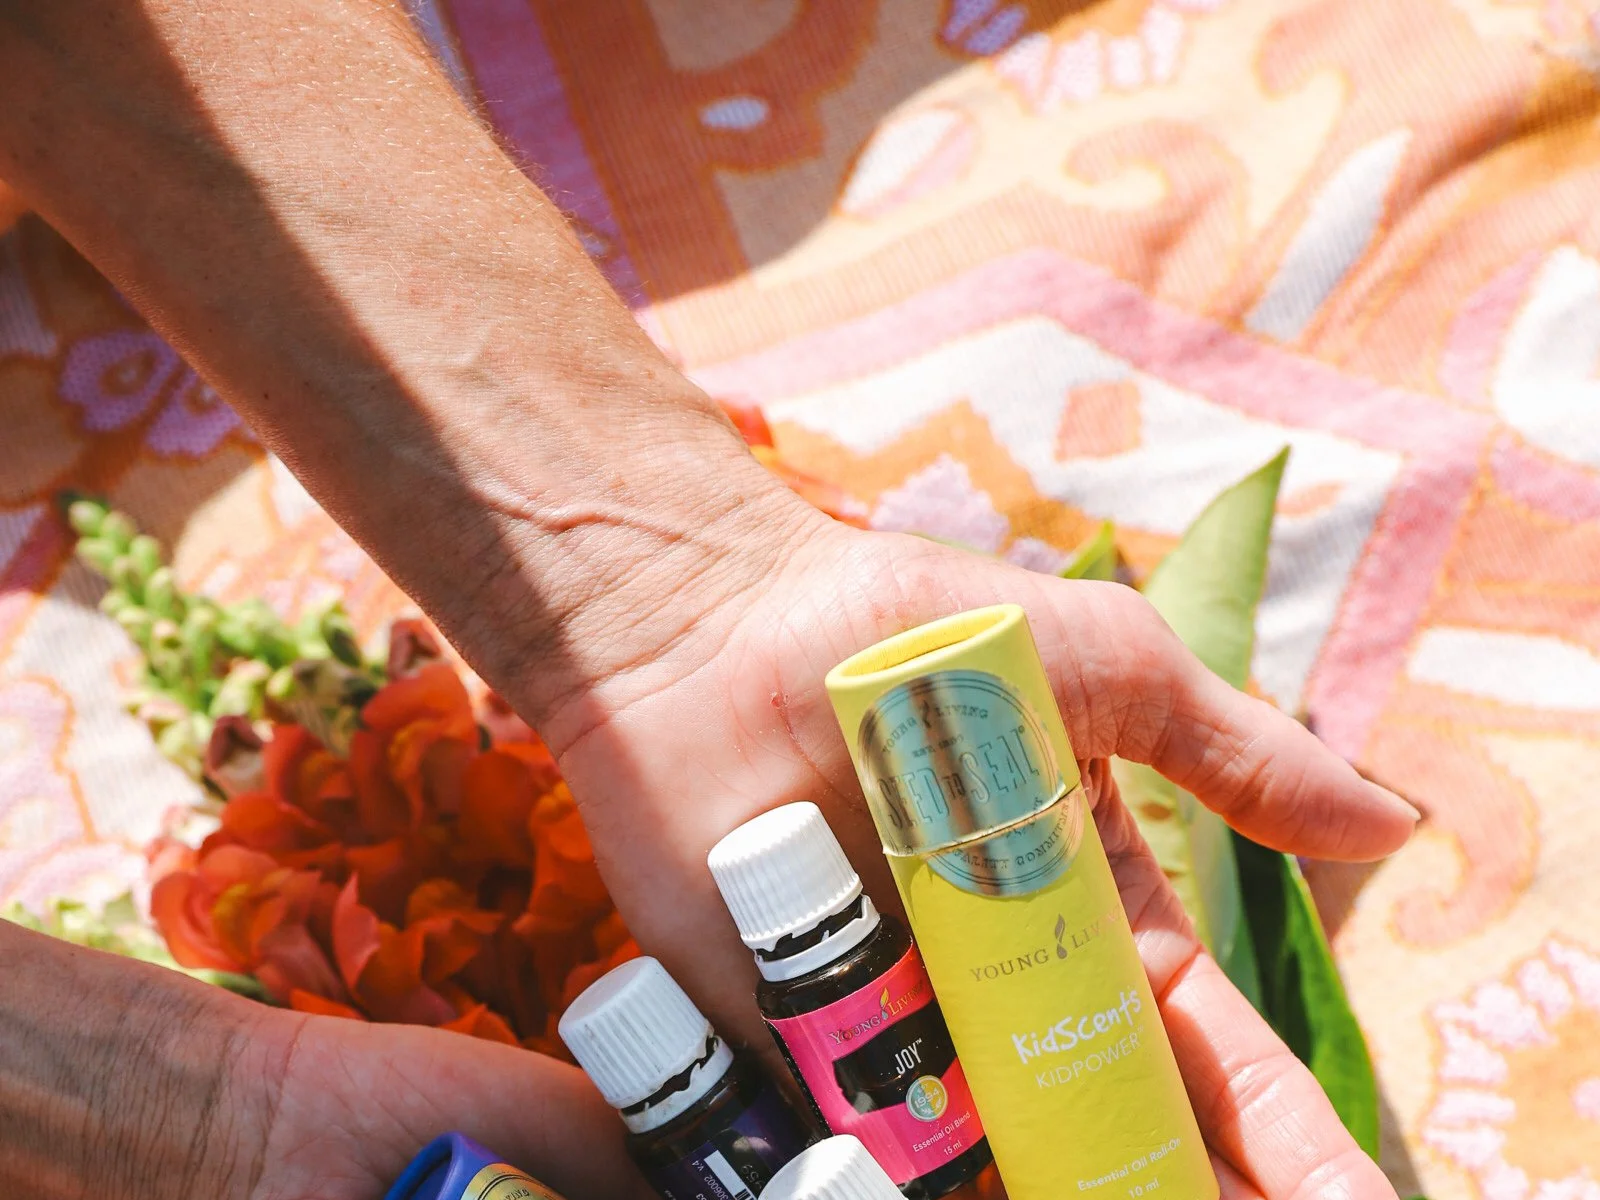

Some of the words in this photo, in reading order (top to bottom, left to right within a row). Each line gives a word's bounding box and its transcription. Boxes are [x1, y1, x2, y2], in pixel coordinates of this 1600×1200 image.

[877, 767, 950, 831] SEED
[969, 948, 1050, 983] YOUNG
[828, 1015, 881, 1045] YOUNG
[1011, 988, 1142, 1065] KidScents
[912, 1131, 945, 1152] Essential
[944, 1125, 954, 1135] Oil
[954, 1111, 971, 1128] Blend
[944, 1147, 953, 1156] 15
[953, 1140, 963, 1150] ml
[1077, 1165, 1129, 1192] Essential
[1131, 1156, 1148, 1172] Oil
[1127, 1186, 1143, 1200] 10
[1146, 1178, 1160, 1192] ml
